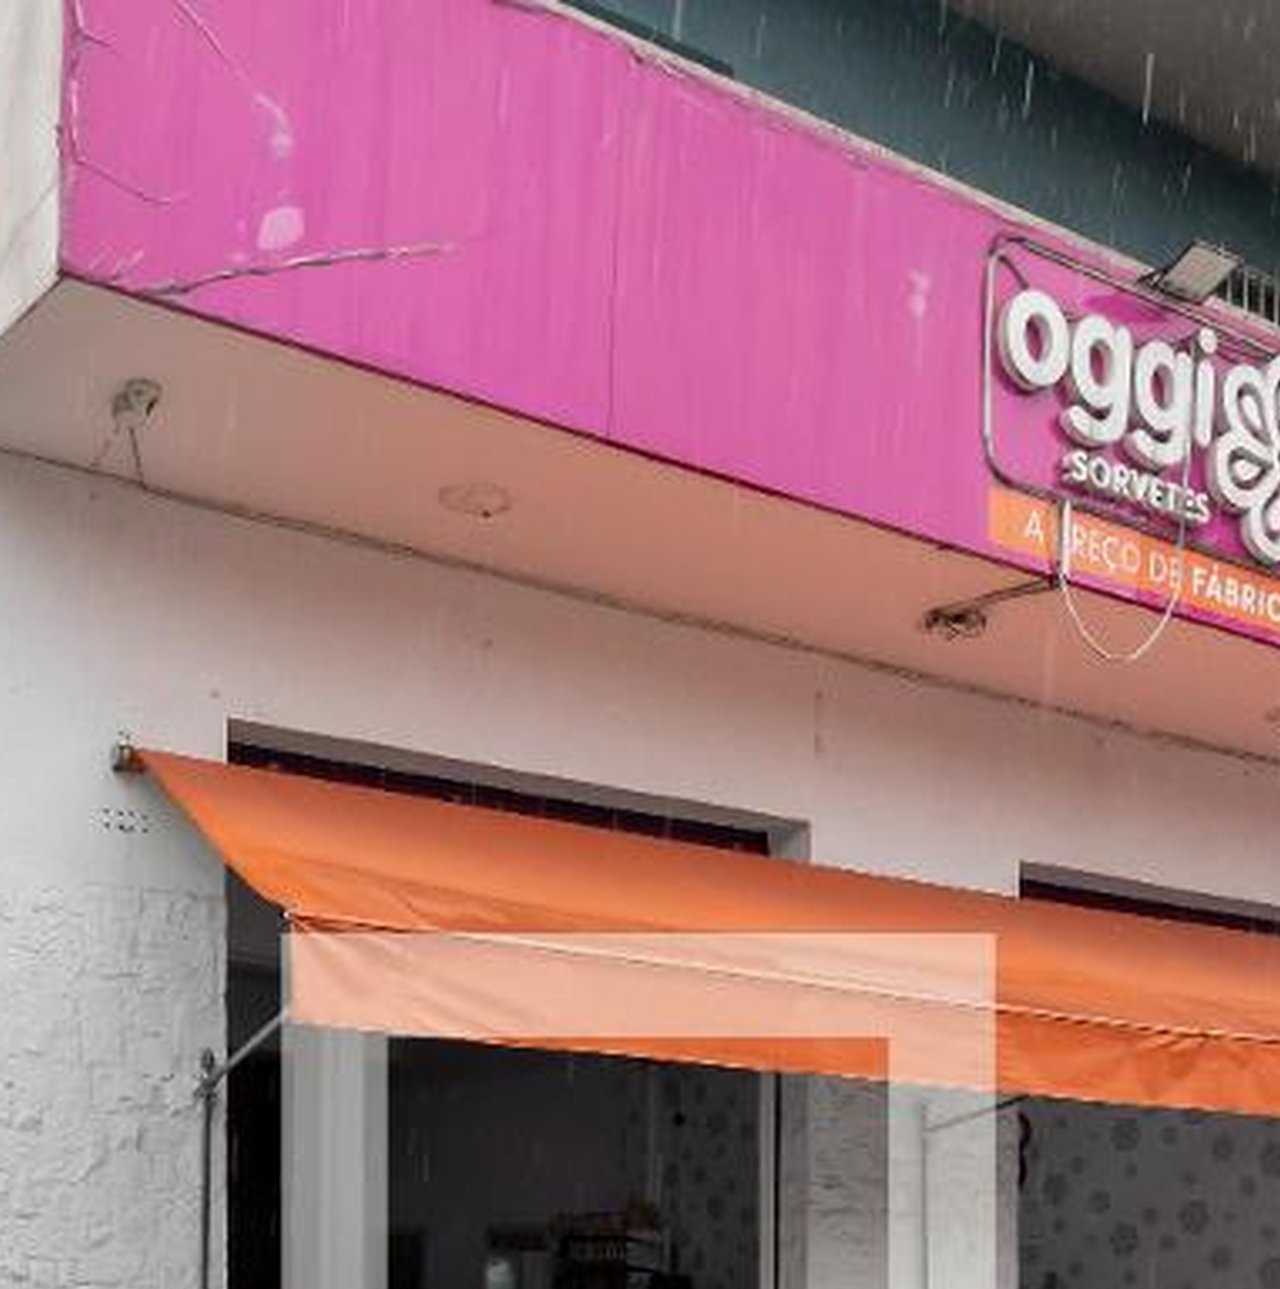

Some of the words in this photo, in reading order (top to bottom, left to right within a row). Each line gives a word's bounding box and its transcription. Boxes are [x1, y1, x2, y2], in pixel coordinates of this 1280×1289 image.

[1000, 290, 1218, 467] oggi
[1064, 450, 1211, 523] SORVETES
[1023, 510, 1045, 544] A
[1061, 516, 1141, 575] REÇO
[1148, 551, 1181, 589] DE
